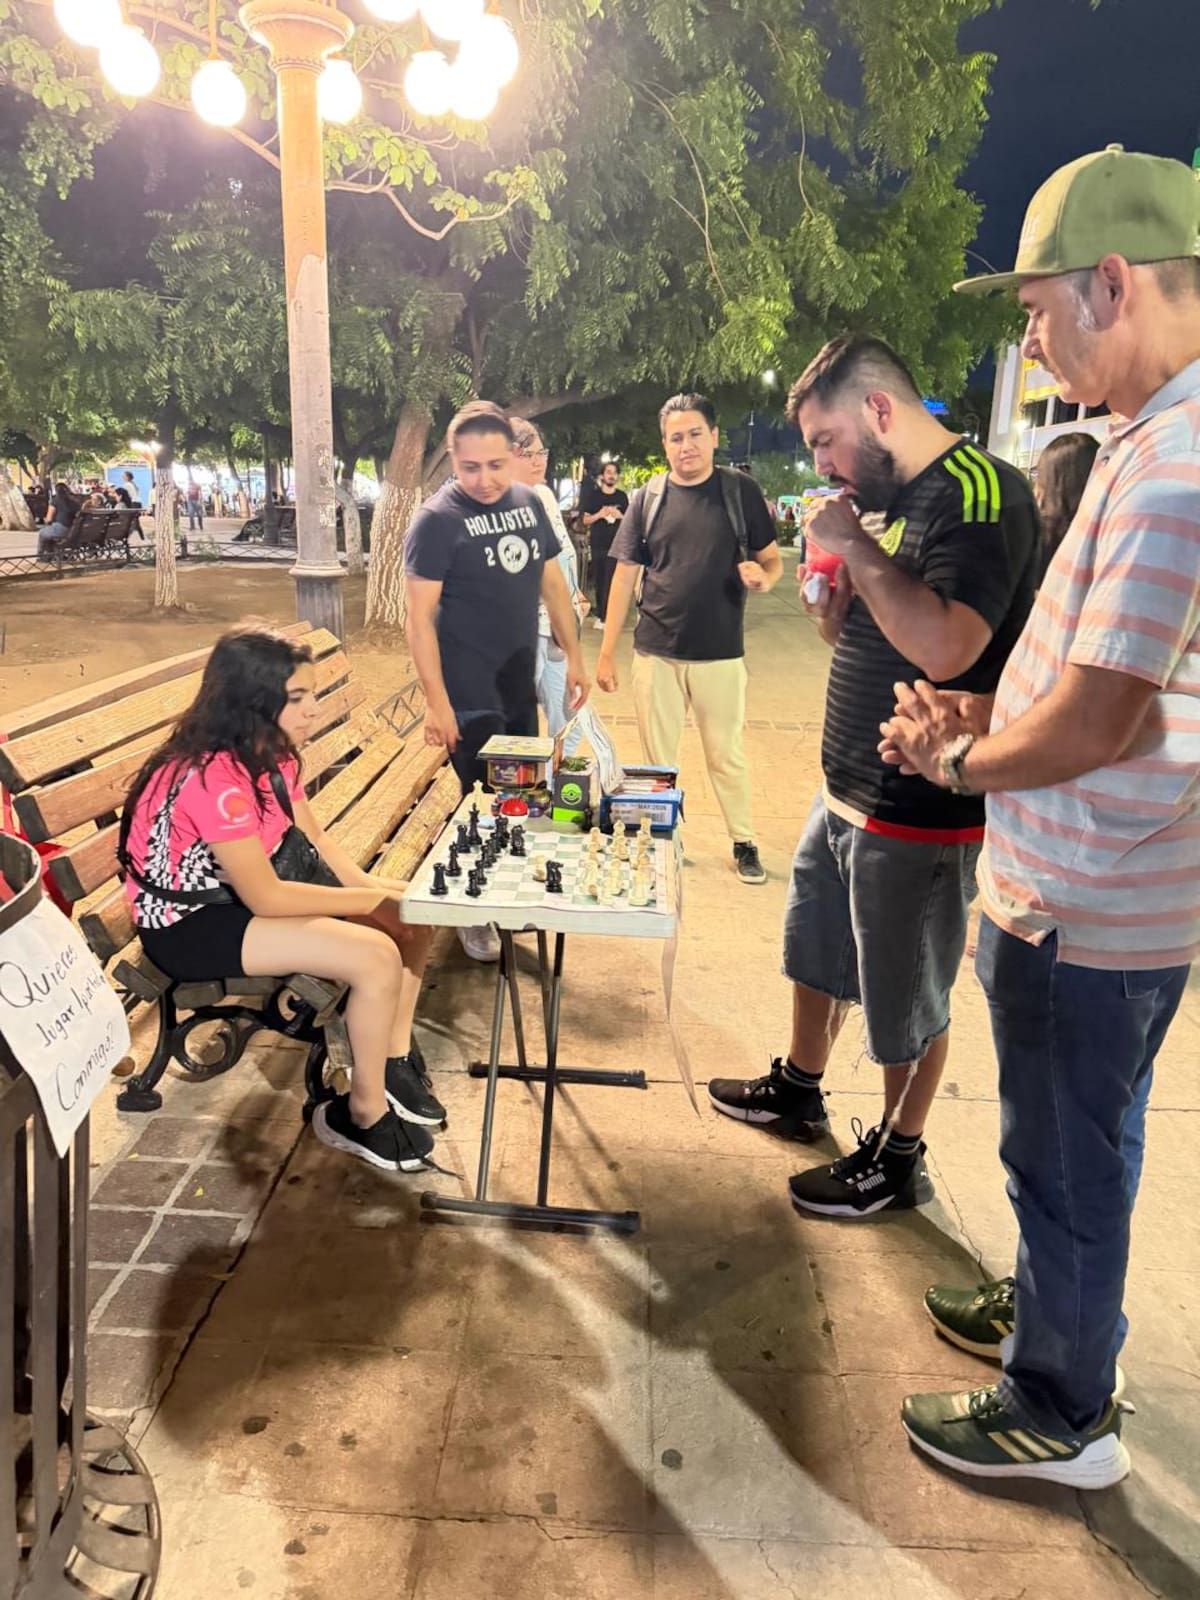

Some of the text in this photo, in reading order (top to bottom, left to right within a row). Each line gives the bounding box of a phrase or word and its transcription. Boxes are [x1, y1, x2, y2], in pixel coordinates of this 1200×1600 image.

[464, 506, 538, 537] HOLLISTER
[484, 538, 541, 567] 2 2
[856, 1172, 886, 1193] PUMA
